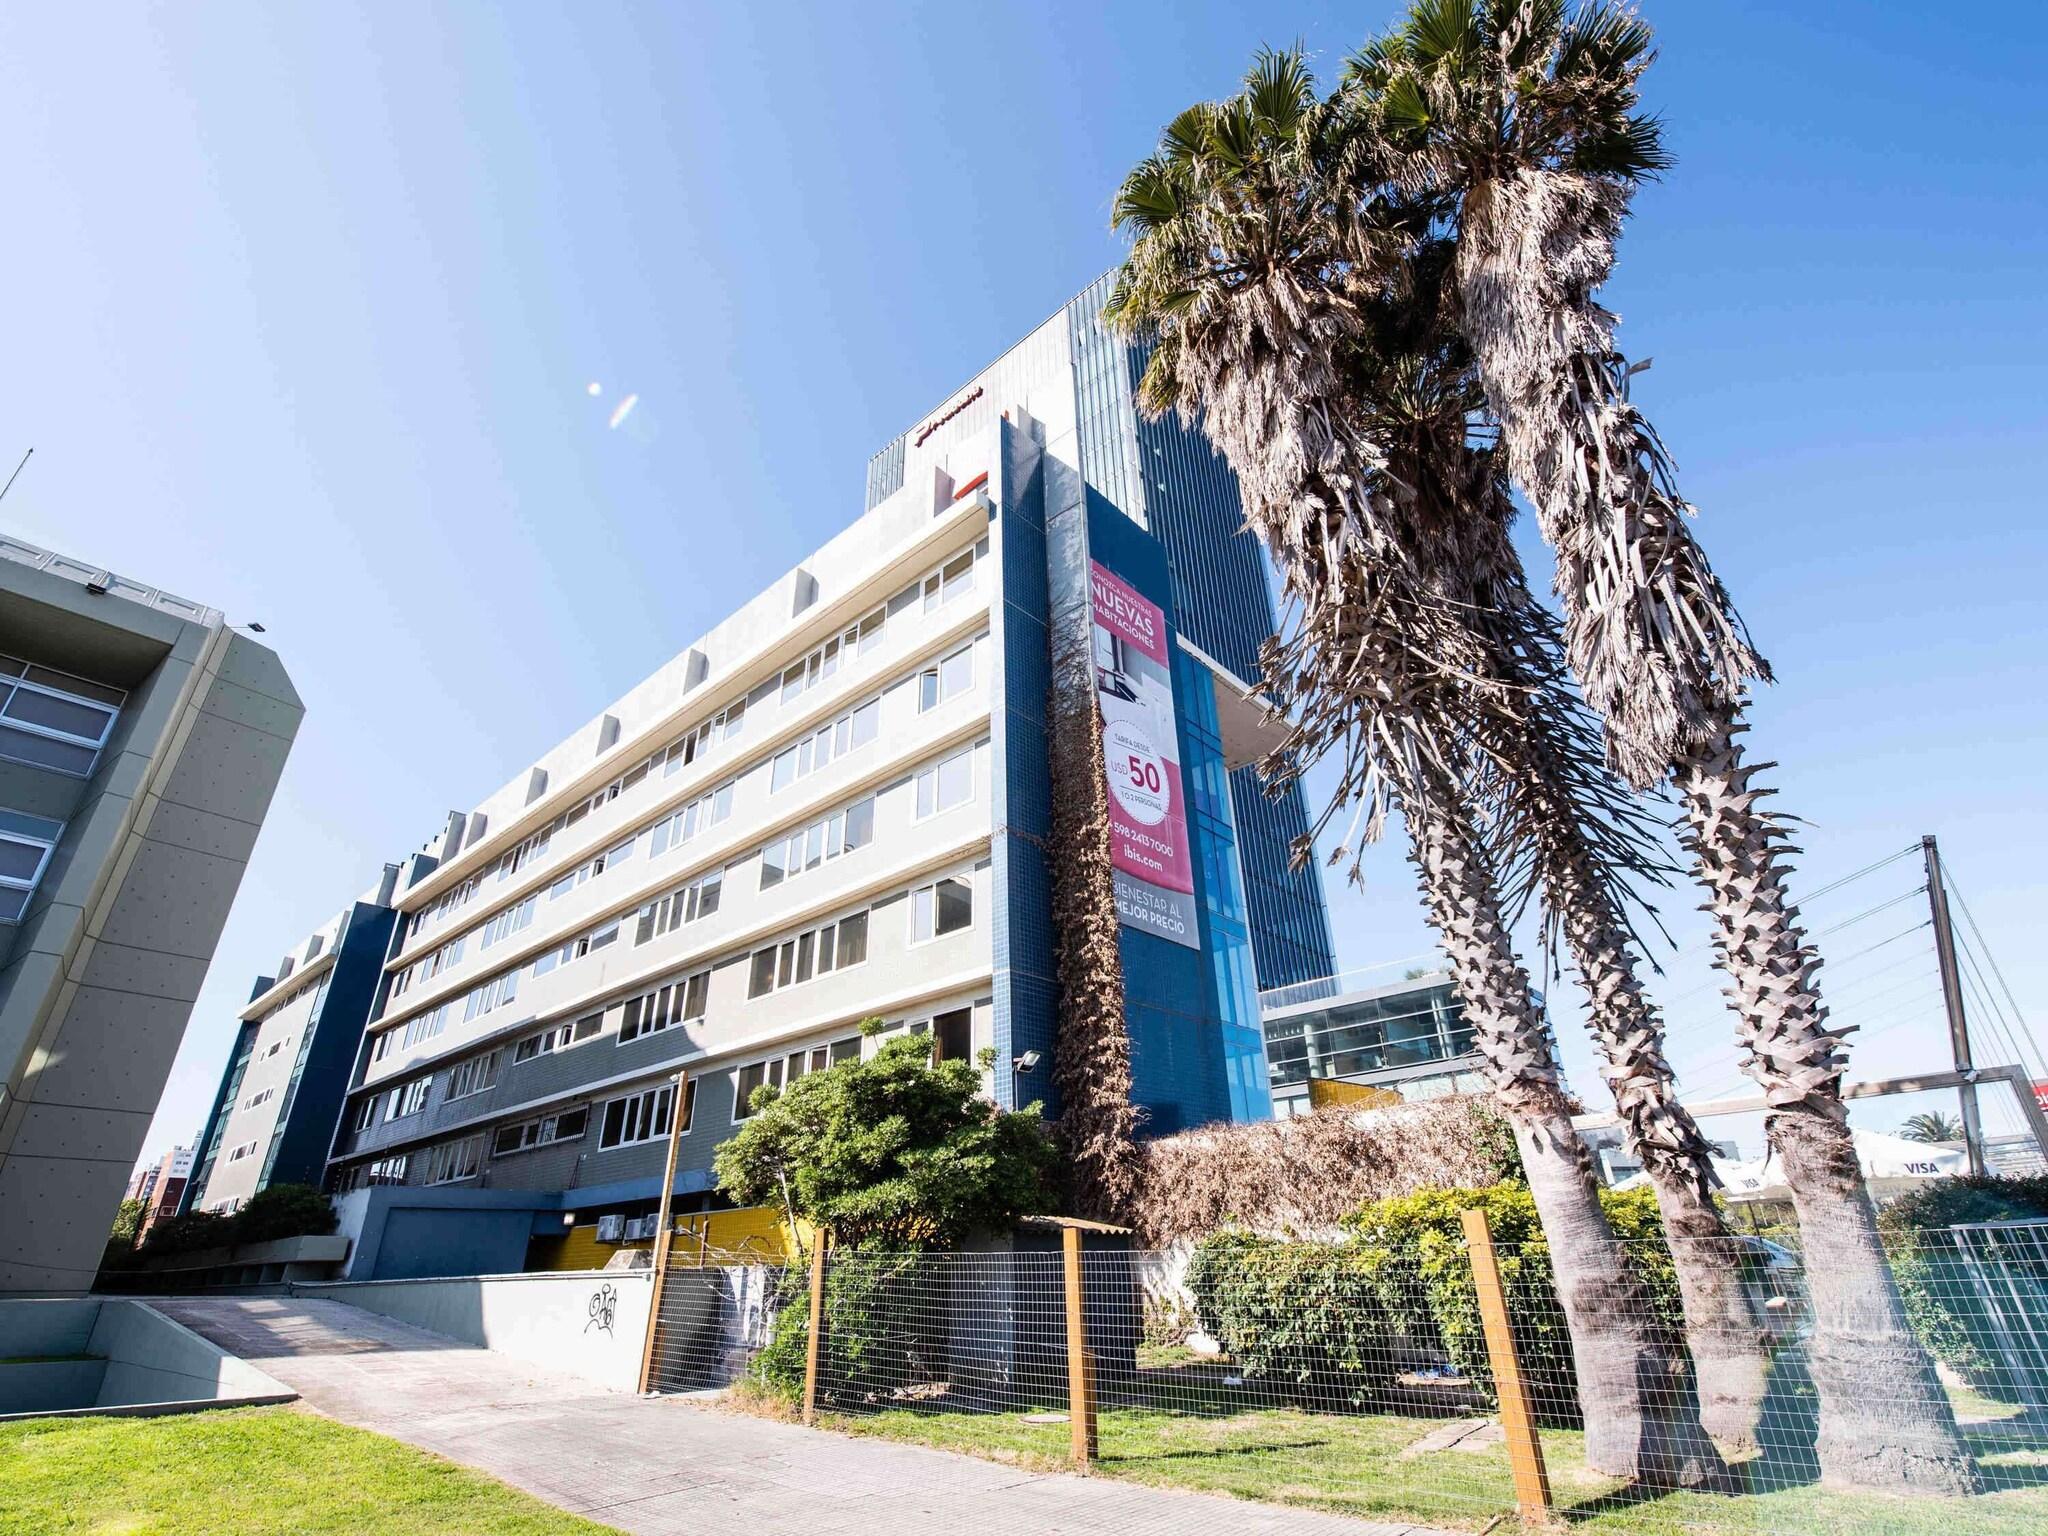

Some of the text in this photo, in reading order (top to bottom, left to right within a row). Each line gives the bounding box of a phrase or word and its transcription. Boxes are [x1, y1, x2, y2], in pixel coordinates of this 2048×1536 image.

[1091, 581, 1154, 636] NUEVAS
[1092, 601, 1155, 650] HABITACIONES
[1111, 754, 1161, 794] USD 50
[1123, 843, 1163, 872] ibis.com
[1149, 838, 1174, 857] 7000
[1150, 911, 1185, 935] PRECIO
[1169, 903, 1183, 920] AL
[1903, 1162, 1940, 1174] VISA
